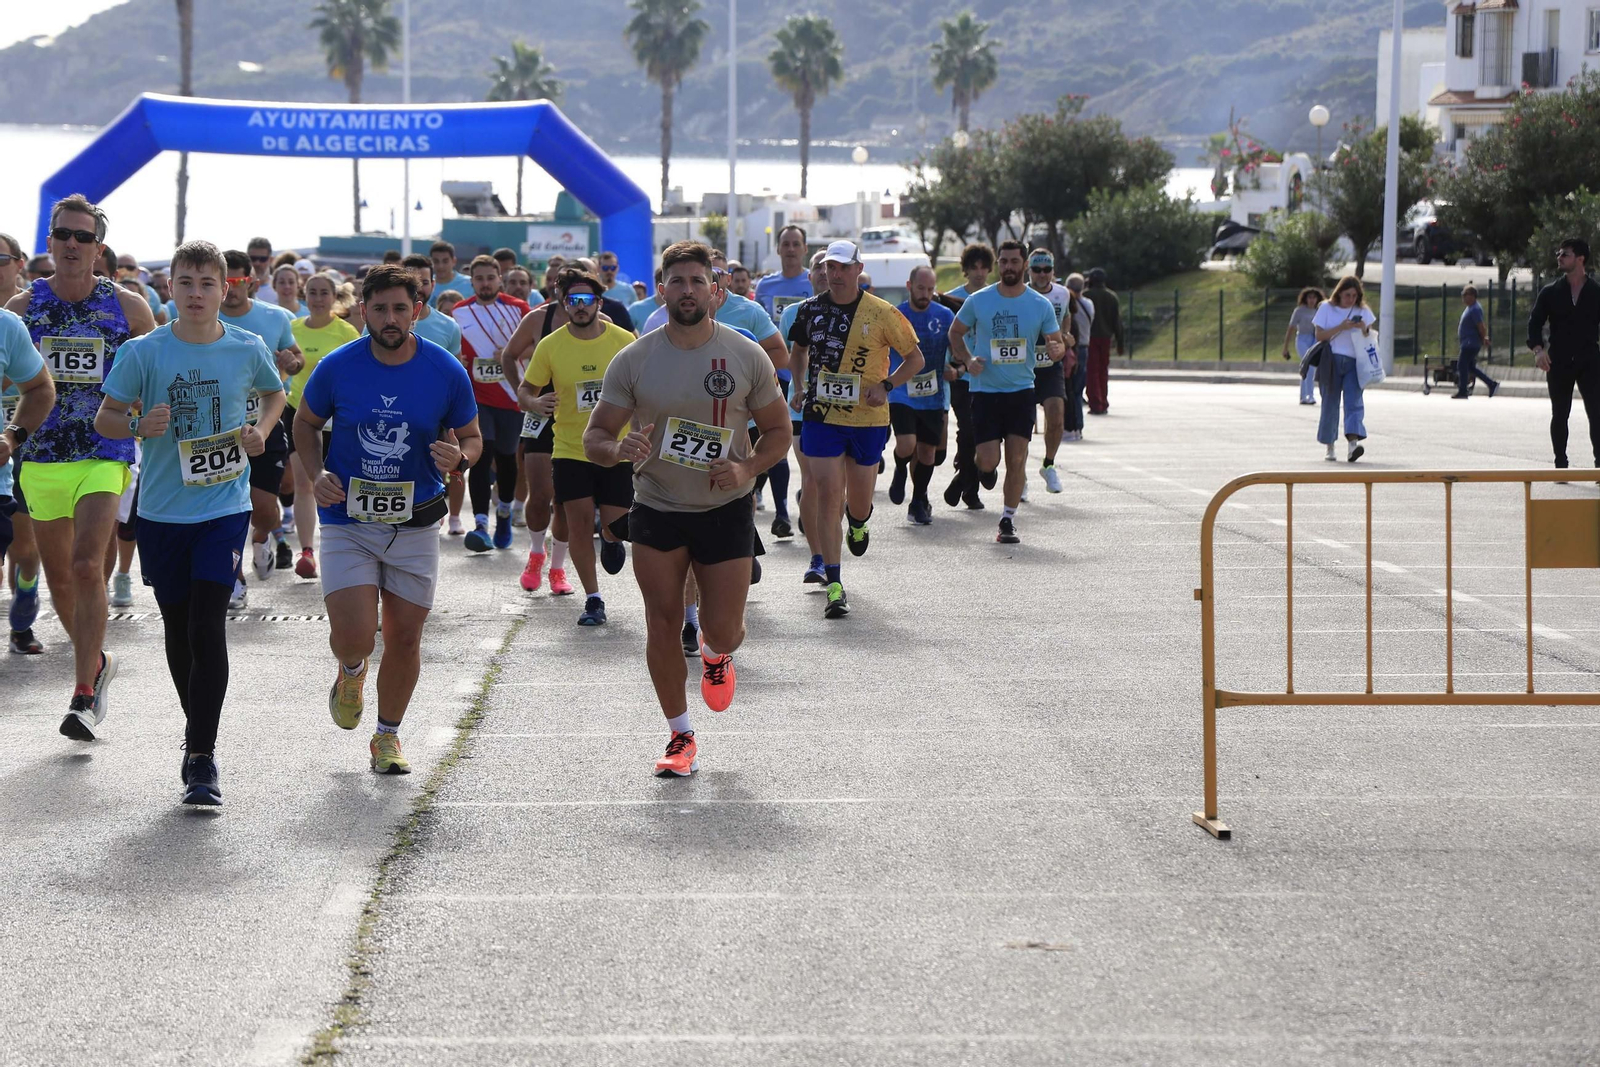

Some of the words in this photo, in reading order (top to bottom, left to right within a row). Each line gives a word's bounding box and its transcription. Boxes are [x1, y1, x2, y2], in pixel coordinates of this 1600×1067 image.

[247, 111, 443, 129] AYUNTAMIENTO
[262, 136, 289, 150] DE
[295, 135, 430, 152] ALGECIRAS
[999, 346, 1018, 357] 60
[47, 352, 97, 370] 163
[477, 364, 503, 376] 148
[193, 384, 220, 398] URBANA
[822, 382, 853, 397] 131
[915, 380, 932, 390] 44
[670, 432, 723, 459] 279
[189, 445, 242, 475] 204
[361, 464, 400, 474] MARATÓN
[355, 495, 407, 512] 166
